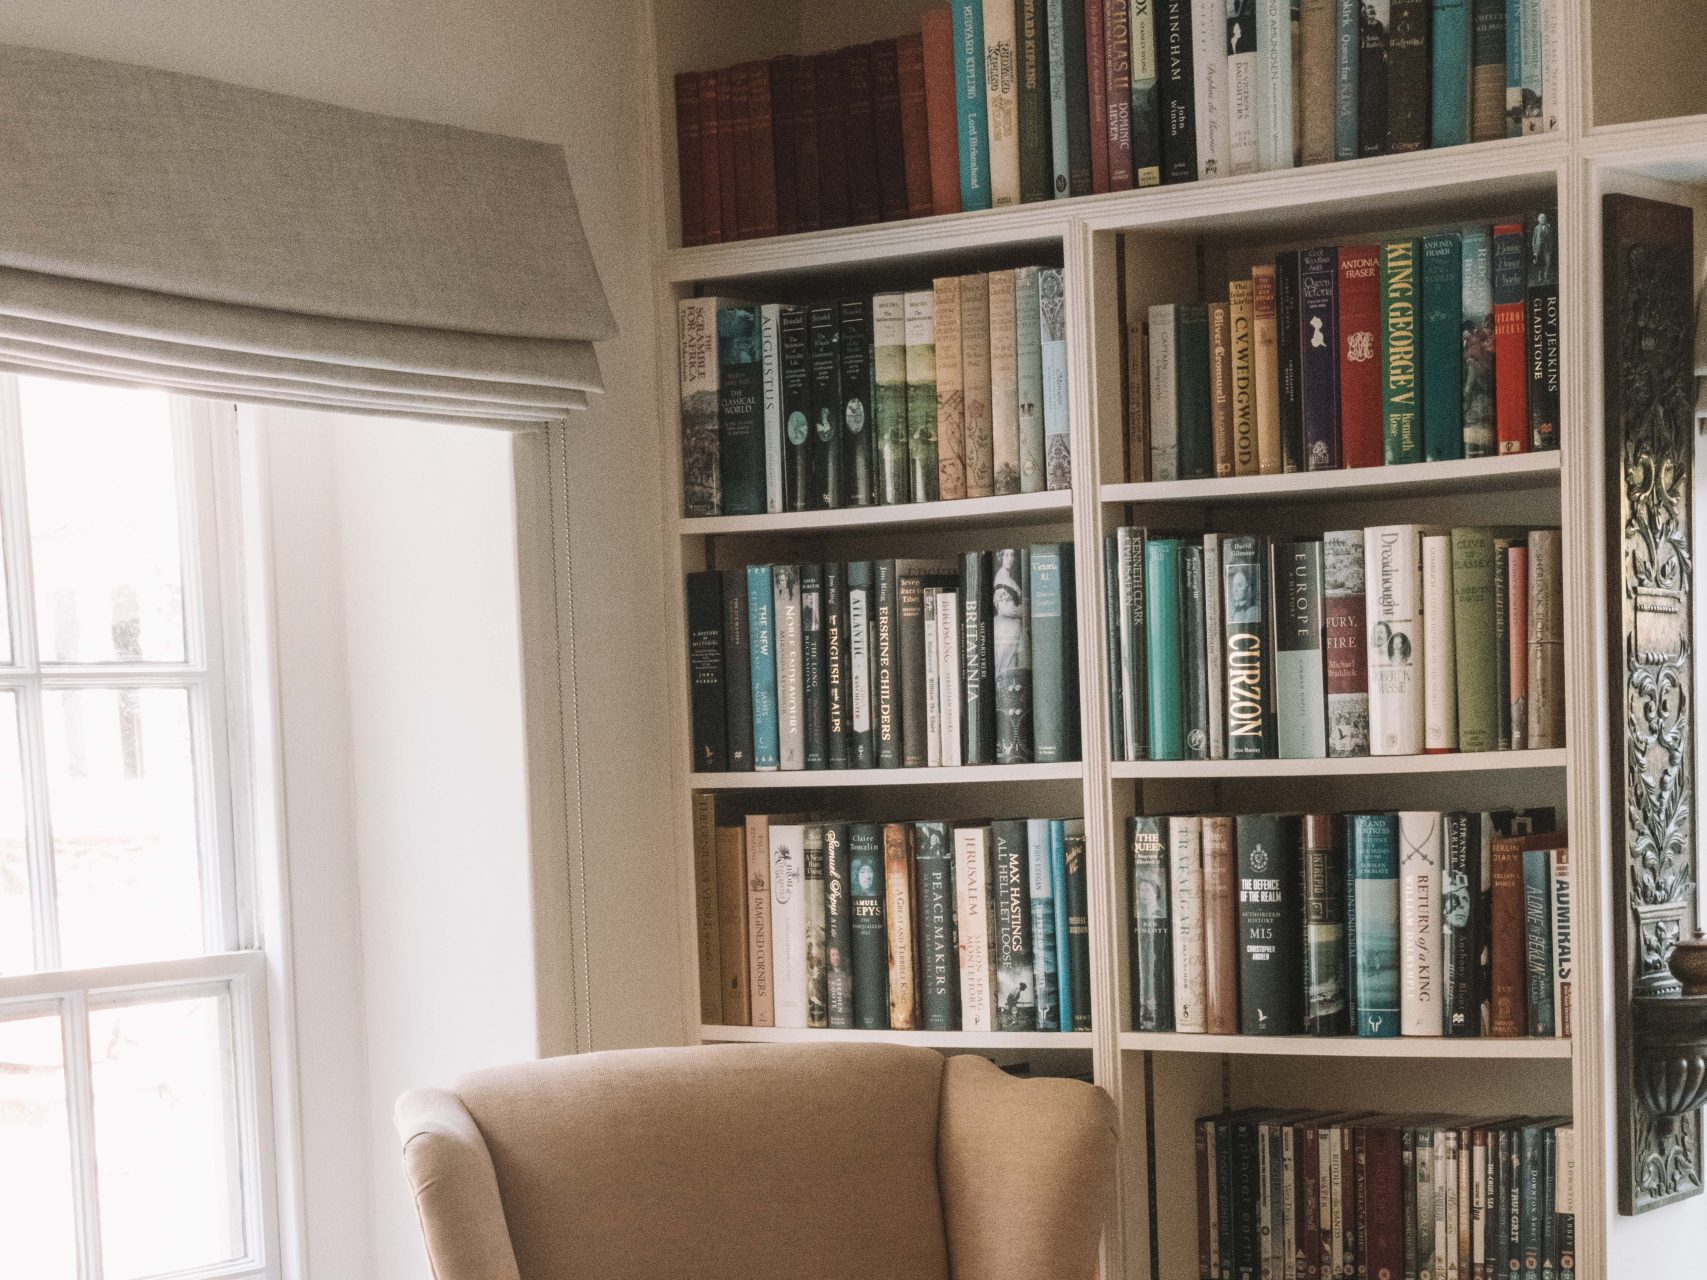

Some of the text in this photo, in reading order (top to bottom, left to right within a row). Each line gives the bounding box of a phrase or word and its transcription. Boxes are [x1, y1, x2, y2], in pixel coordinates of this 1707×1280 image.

[1270, 20, 1279, 80] AMUNDSEN
[1109, 104, 1118, 142] LIEVEN
[1118, 102, 1129, 149] DOMINIC
[1177, 106, 1186, 128] John
[1341, 258, 1380, 269] ANTONIA
[1346, 268, 1375, 279] FRASER
[686, 306, 697, 381] FOR AFRICA
[695, 307, 706, 379] SCRAMBLE
[1386, 241, 1415, 405] KING GEORGE V
[1533, 298, 1543, 380] GLADSTONE
[1547, 296, 1557, 392] ROY JENKINS
[762, 316, 774, 410] AUGUSTUS
[1214, 309, 1225, 403] Oliver Cromwell
[724, 406, 751, 414] WORLD
[1236, 346, 1252, 466] WEDGWOOD
[1389, 413, 1402, 436] Rose
[1401, 413, 1416, 451] Kenneth
[1123, 536, 1133, 606] CIVILISATION
[1132, 537, 1143, 625] KENNETH CLARK
[1294, 553, 1309, 637] EUROPE
[1379, 532, 1399, 617] Dreadnought
[1535, 553, 1544, 608] SHERLOCK
[758, 604, 769, 655] THE NEW
[852, 598, 862, 659] ATLANTIC
[941, 601, 952, 663] BIRDSONG
[1327, 616, 1357, 628] FURY,
[1327, 637, 1357, 649] FIRE
[830, 628, 841, 732] ENGLISH ALPS
[879, 566, 890, 741] Jim Ring ERSKINE CHILDERS
[965, 601, 979, 703] BRITANNIA
[1328, 659, 1355, 668] Michael
[1228, 633, 1263, 737] CURZON
[850, 843, 879, 852] Tomalin
[851, 835, 874, 843] Claire
[1138, 833, 1159, 842] THE
[1451, 823, 1459, 864] CARTER
[1459, 818, 1467, 868] MIRANDA
[827, 830, 842, 916] Samuel Pepys
[964, 838, 978, 916] JERUSALEM
[1178, 826, 1190, 936] TRAFALGAR
[1240, 891, 1282, 902] OF THE REALM
[1242, 879, 1280, 890] THE DEFENCE
[1312, 853, 1324, 894] INTREPID
[1405, 875, 1415, 926] WILLIAM
[896, 897, 905, 925] GREAT
[997, 837, 1011, 968] ALL HELL LET LOOSE
[1009, 853, 1022, 952] MAX HASTINGS
[1417, 875, 1429, 934] RETURN
[1526, 886, 1546, 976] ALONE BERLIN
[755, 897, 766, 997] IMAGINED CORNERS
[932, 871, 946, 995] PEACEMAKERS
[1250, 928, 1272, 939] MI5
[1418, 938, 1430, 951] of
[1418, 965, 1431, 1002] KING
[1537, 979, 1545, 1000] HANS
[1510, 1188, 1519, 1243] TRUE GRIT
